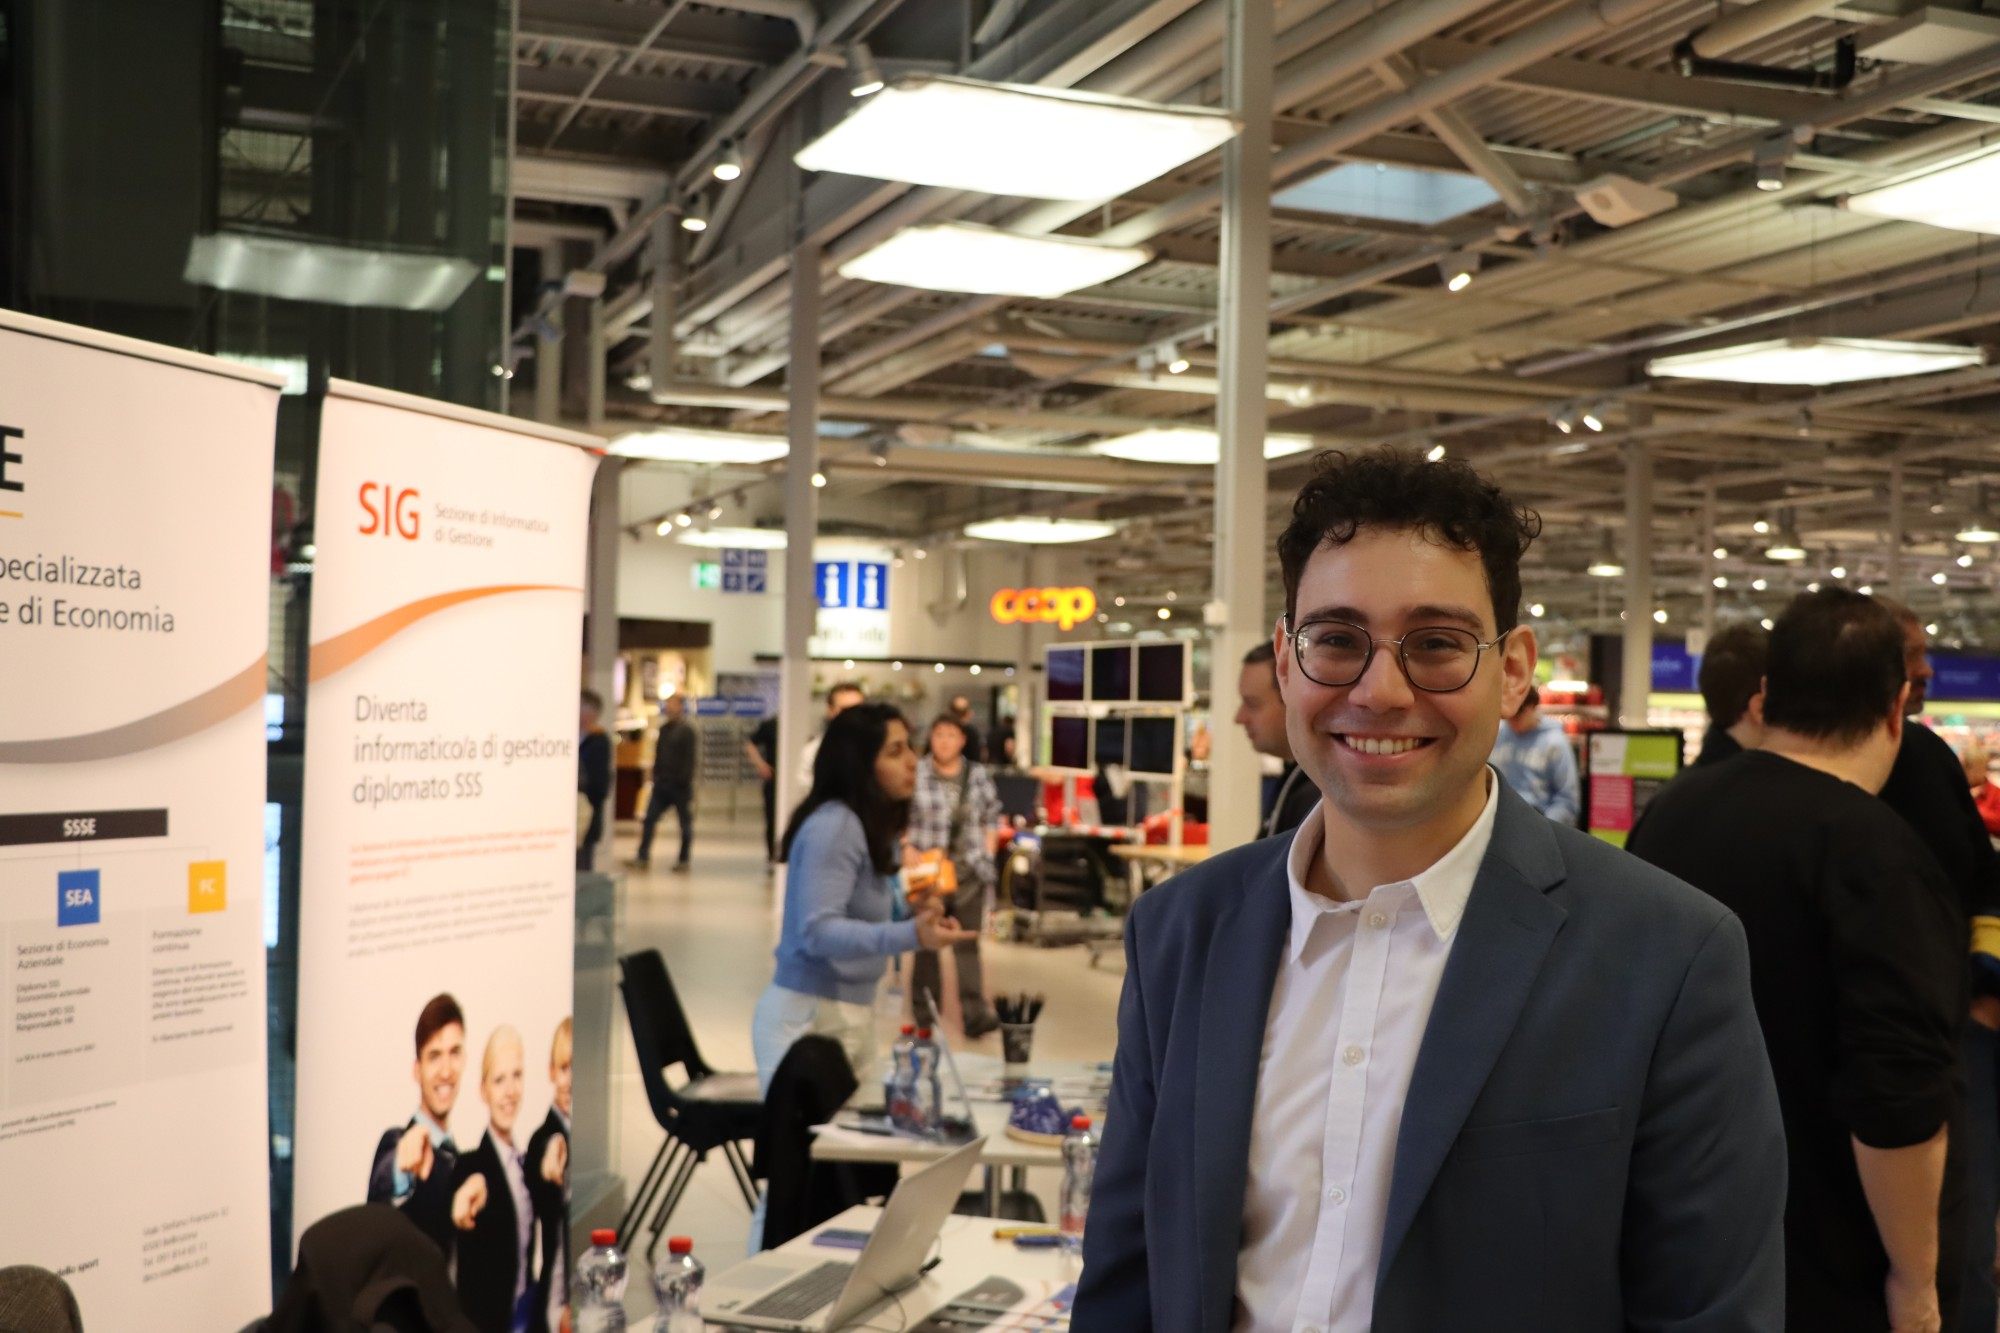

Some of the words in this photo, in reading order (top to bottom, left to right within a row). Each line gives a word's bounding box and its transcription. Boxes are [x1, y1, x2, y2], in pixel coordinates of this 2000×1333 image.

[359, 481, 420, 541] SIG
[434, 502, 477, 522] Sezione
[480, 508, 489, 524] di
[492, 509, 551, 534] Informatica
[434, 527, 446, 543] di
[448, 529, 495, 547] Gestione
[18, 594, 42, 625] di
[53, 598, 175, 633] Economia
[989, 587, 1097, 632] coop
[354, 695, 428, 722] Diventa
[354, 734, 478, 763] informatico/a
[484, 735, 498, 757] di
[503, 737, 573, 765] gestione
[352, 775, 450, 810] diplomato
[454, 772, 484, 799] SSS
[63, 818, 97, 837] SSSE
[64, 888, 94, 908] SEA
